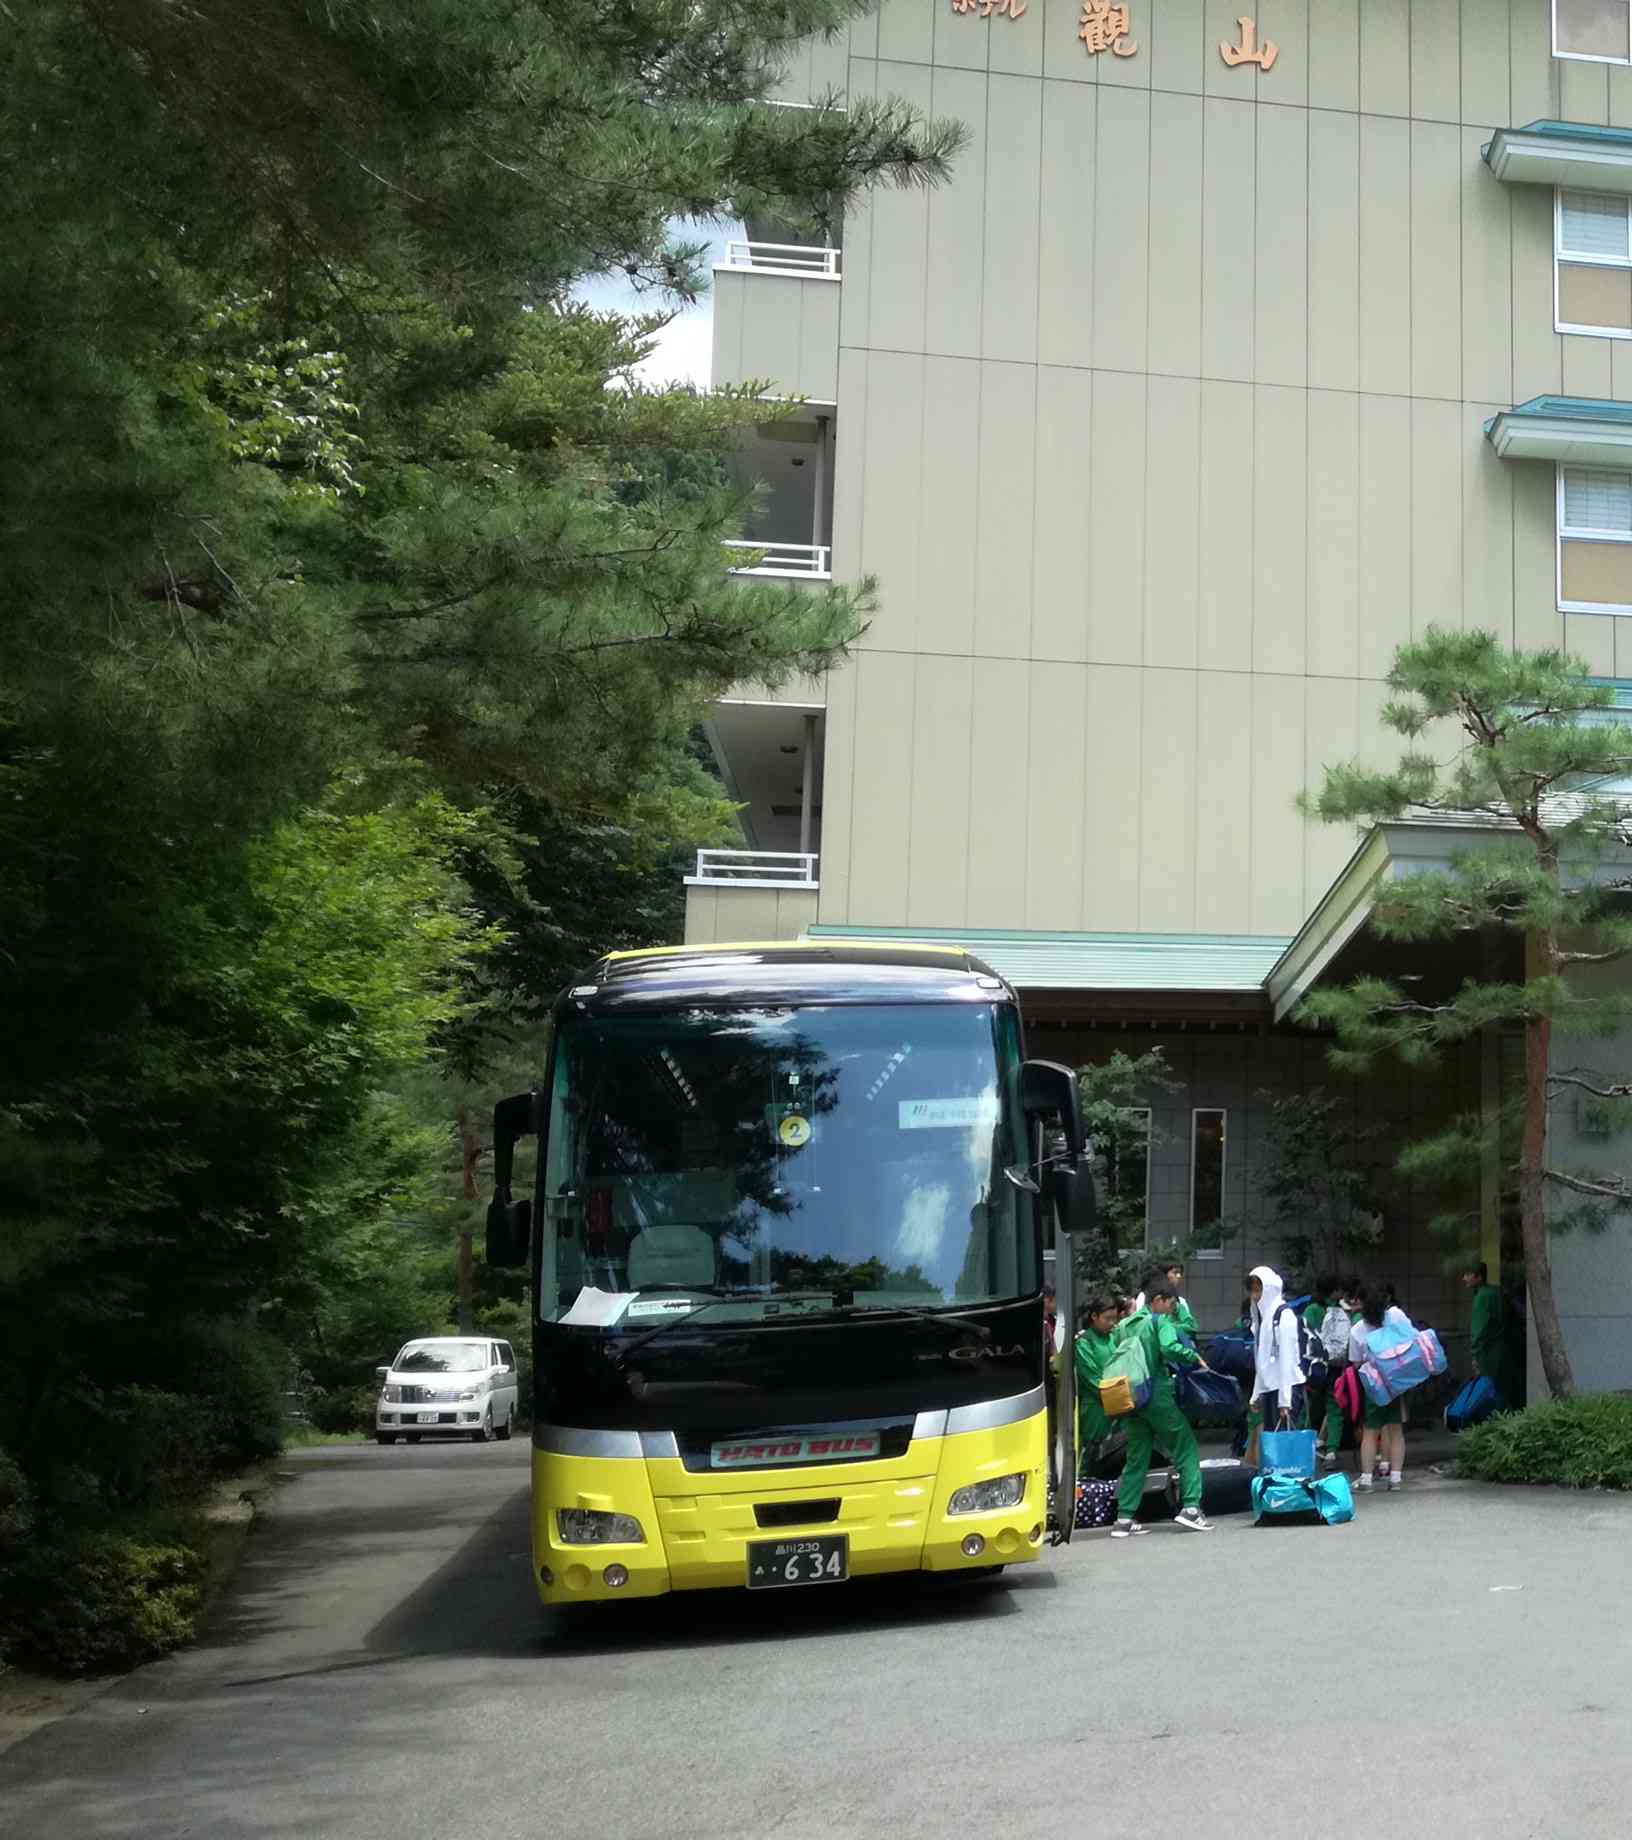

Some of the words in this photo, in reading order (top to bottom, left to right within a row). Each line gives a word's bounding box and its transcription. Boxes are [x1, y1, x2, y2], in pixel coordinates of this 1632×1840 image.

[789, 1123, 803, 1138] 2
[948, 1344, 1025, 1360] GALA
[719, 1440, 801, 1461] HATO
[807, 1439, 874, 1455] BUS
